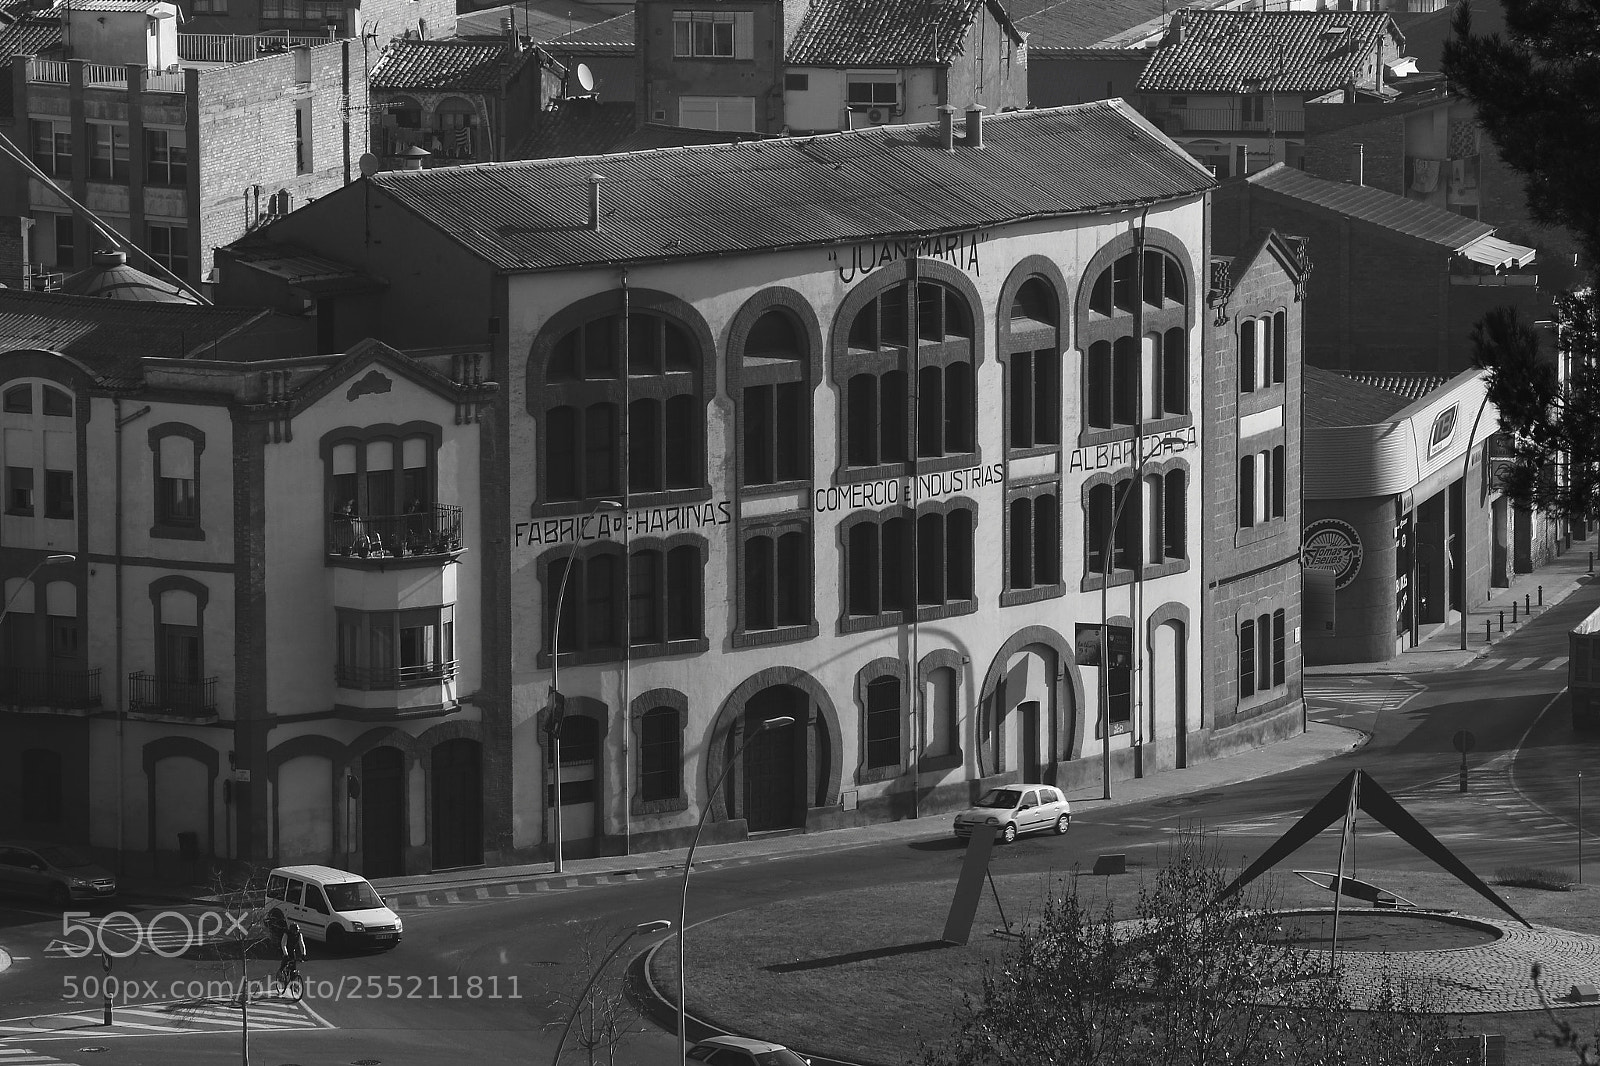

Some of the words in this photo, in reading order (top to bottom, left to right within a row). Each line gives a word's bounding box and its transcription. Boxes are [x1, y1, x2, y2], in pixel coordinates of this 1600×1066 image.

[815, 479, 899, 513] COMERCIO
[916, 463, 1004, 500] INDUSTRIAS
[515, 514, 611, 547] FABRICA
[635, 500, 732, 534] HARINAS
